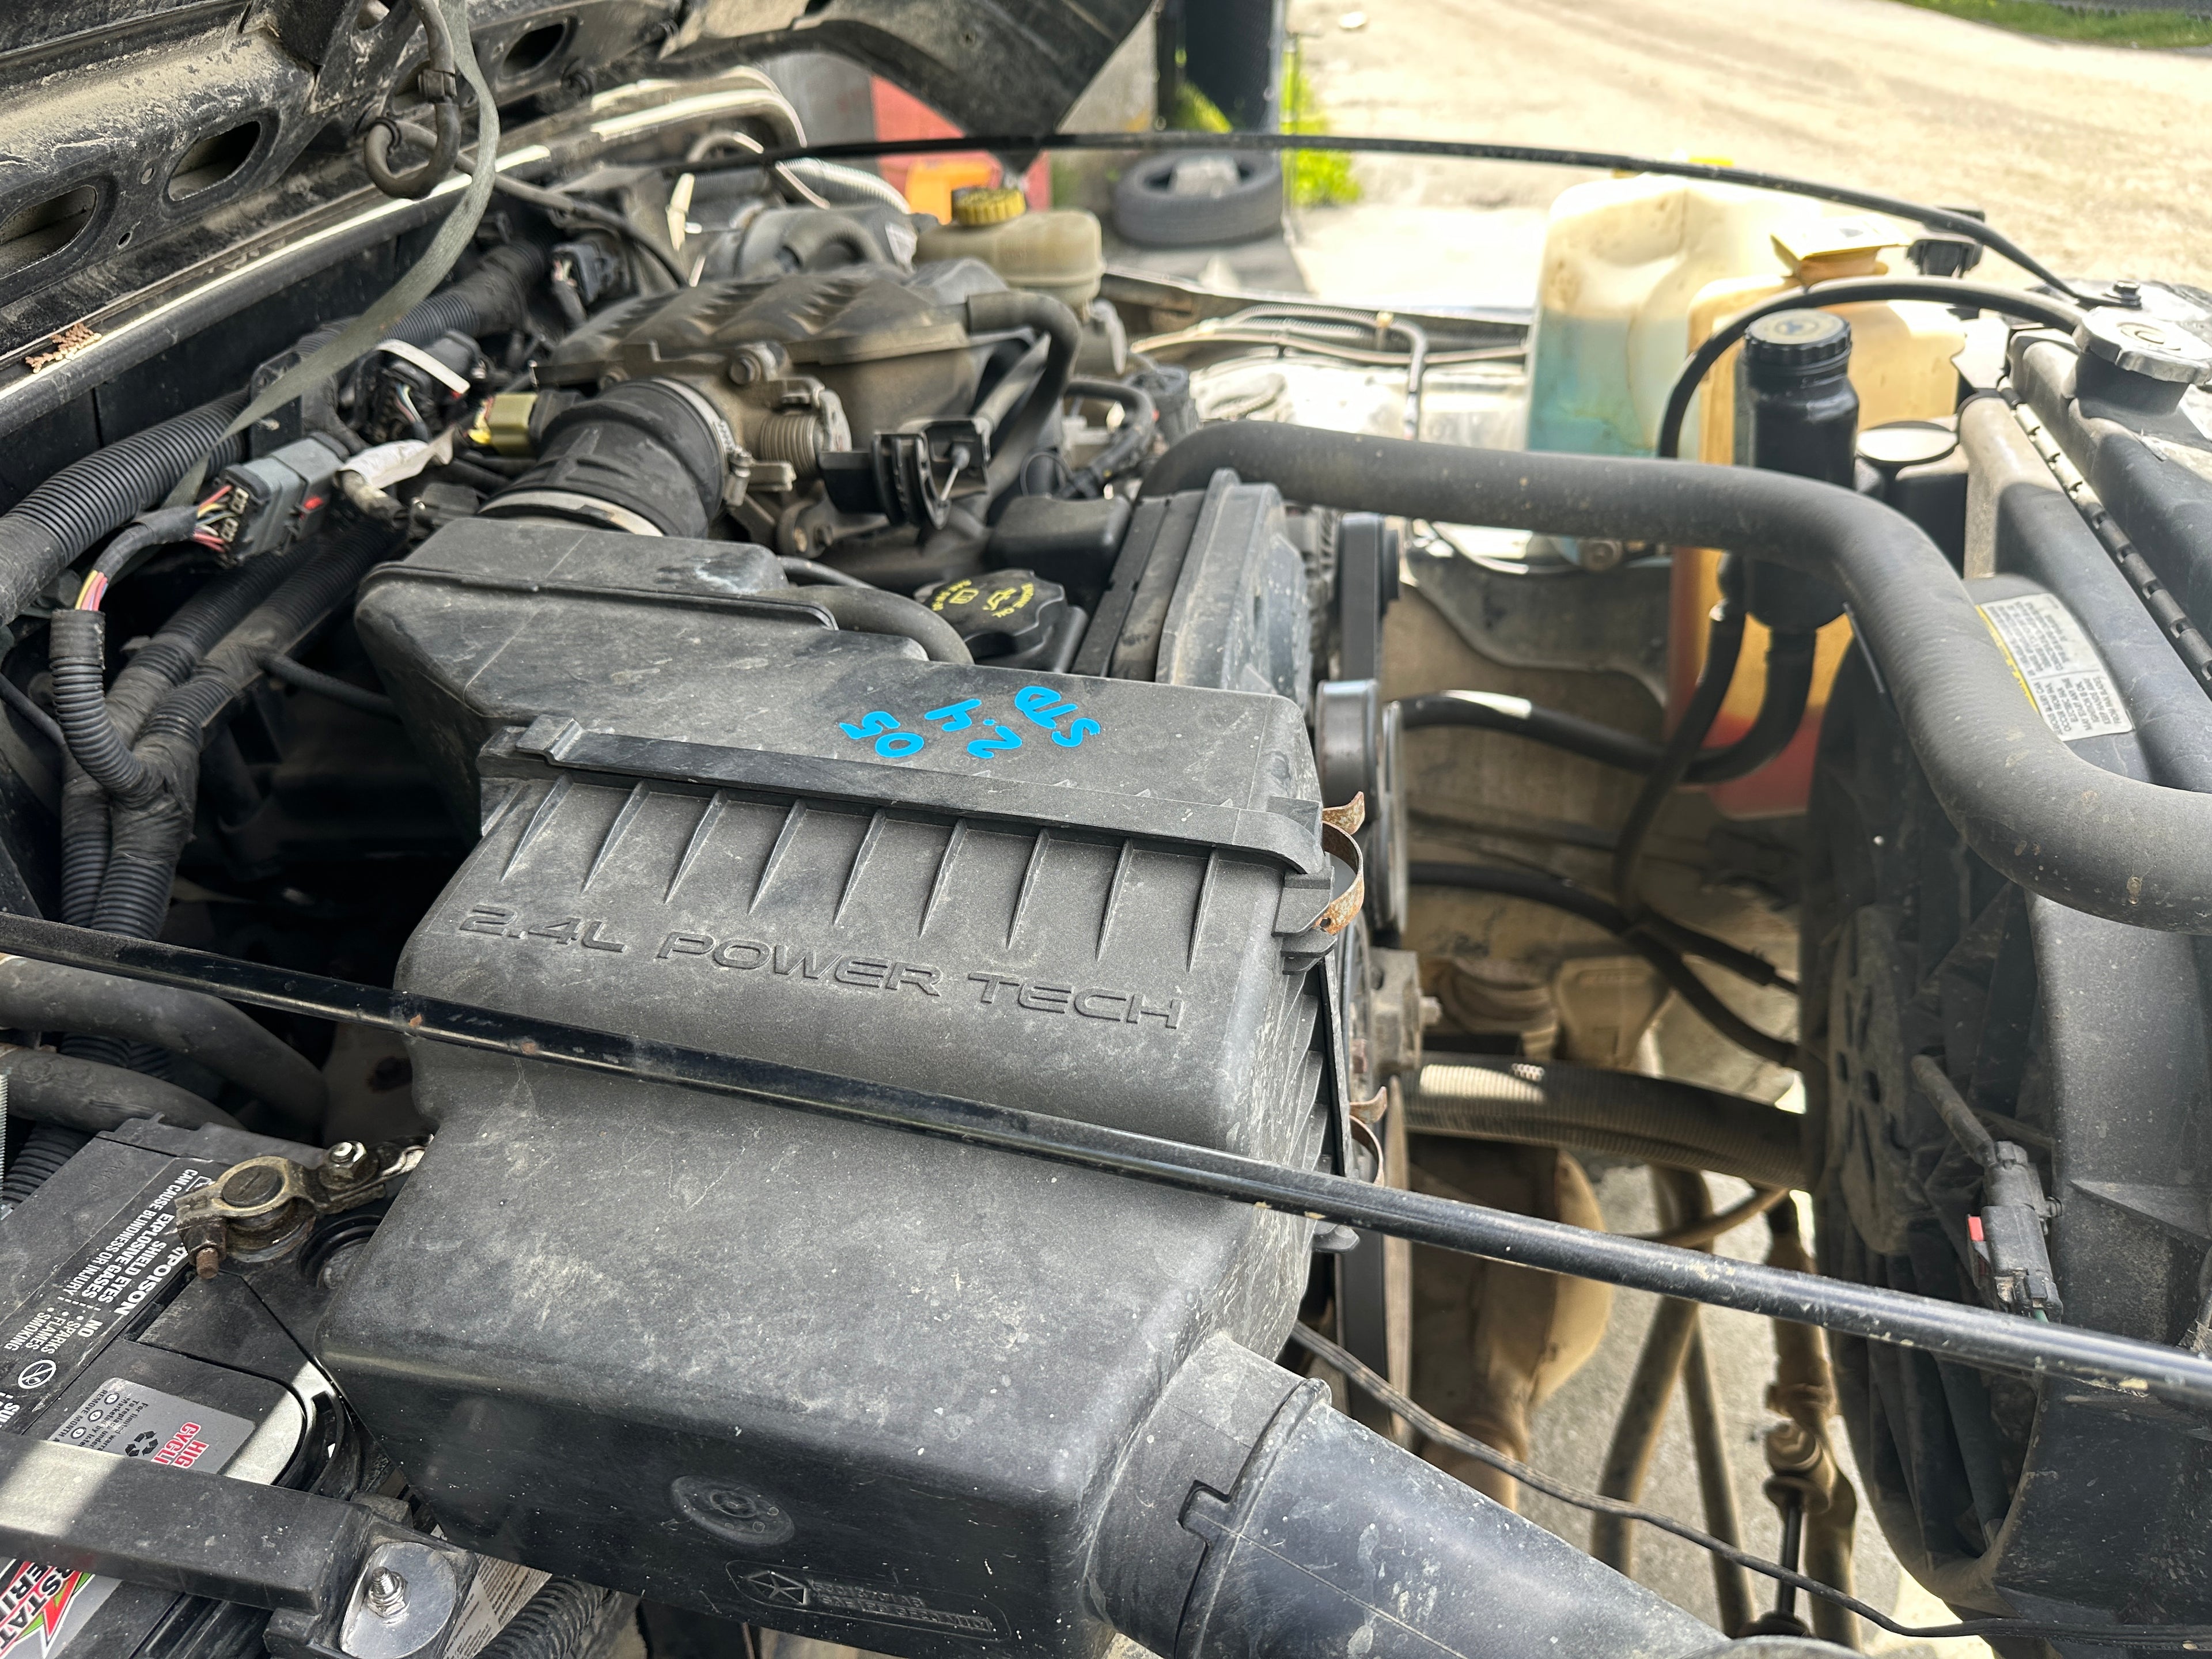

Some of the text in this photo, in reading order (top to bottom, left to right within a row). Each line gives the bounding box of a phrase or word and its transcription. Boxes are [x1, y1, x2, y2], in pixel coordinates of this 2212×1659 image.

[839, 711, 924, 757] 05
[459, 904, 1184, 1030] 2.4L POWER TECH
[63, 1169, 198, 1297] CAN CAUSE BLINDNESS OR INJURY
[82, 1213, 175, 1298] EXPLOSIVE GASES
[98, 1241, 166, 1303] SHIELD EYES
[4, 1312, 51, 1350] SMOKING
[25, 1316, 66, 1351] FLAMES
[41, 1321, 81, 1354] SPARKS
[78, 1319, 103, 1338] NO
[81, 1390, 108, 1414] REMOVE
[136, 1403, 148, 1412] For
[59, 1415, 83, 1437] MONTH
[90, 1431, 108, 1448] under
[115, 1414, 138, 1434] limited
[0, 1563, 48, 1621] ERI
